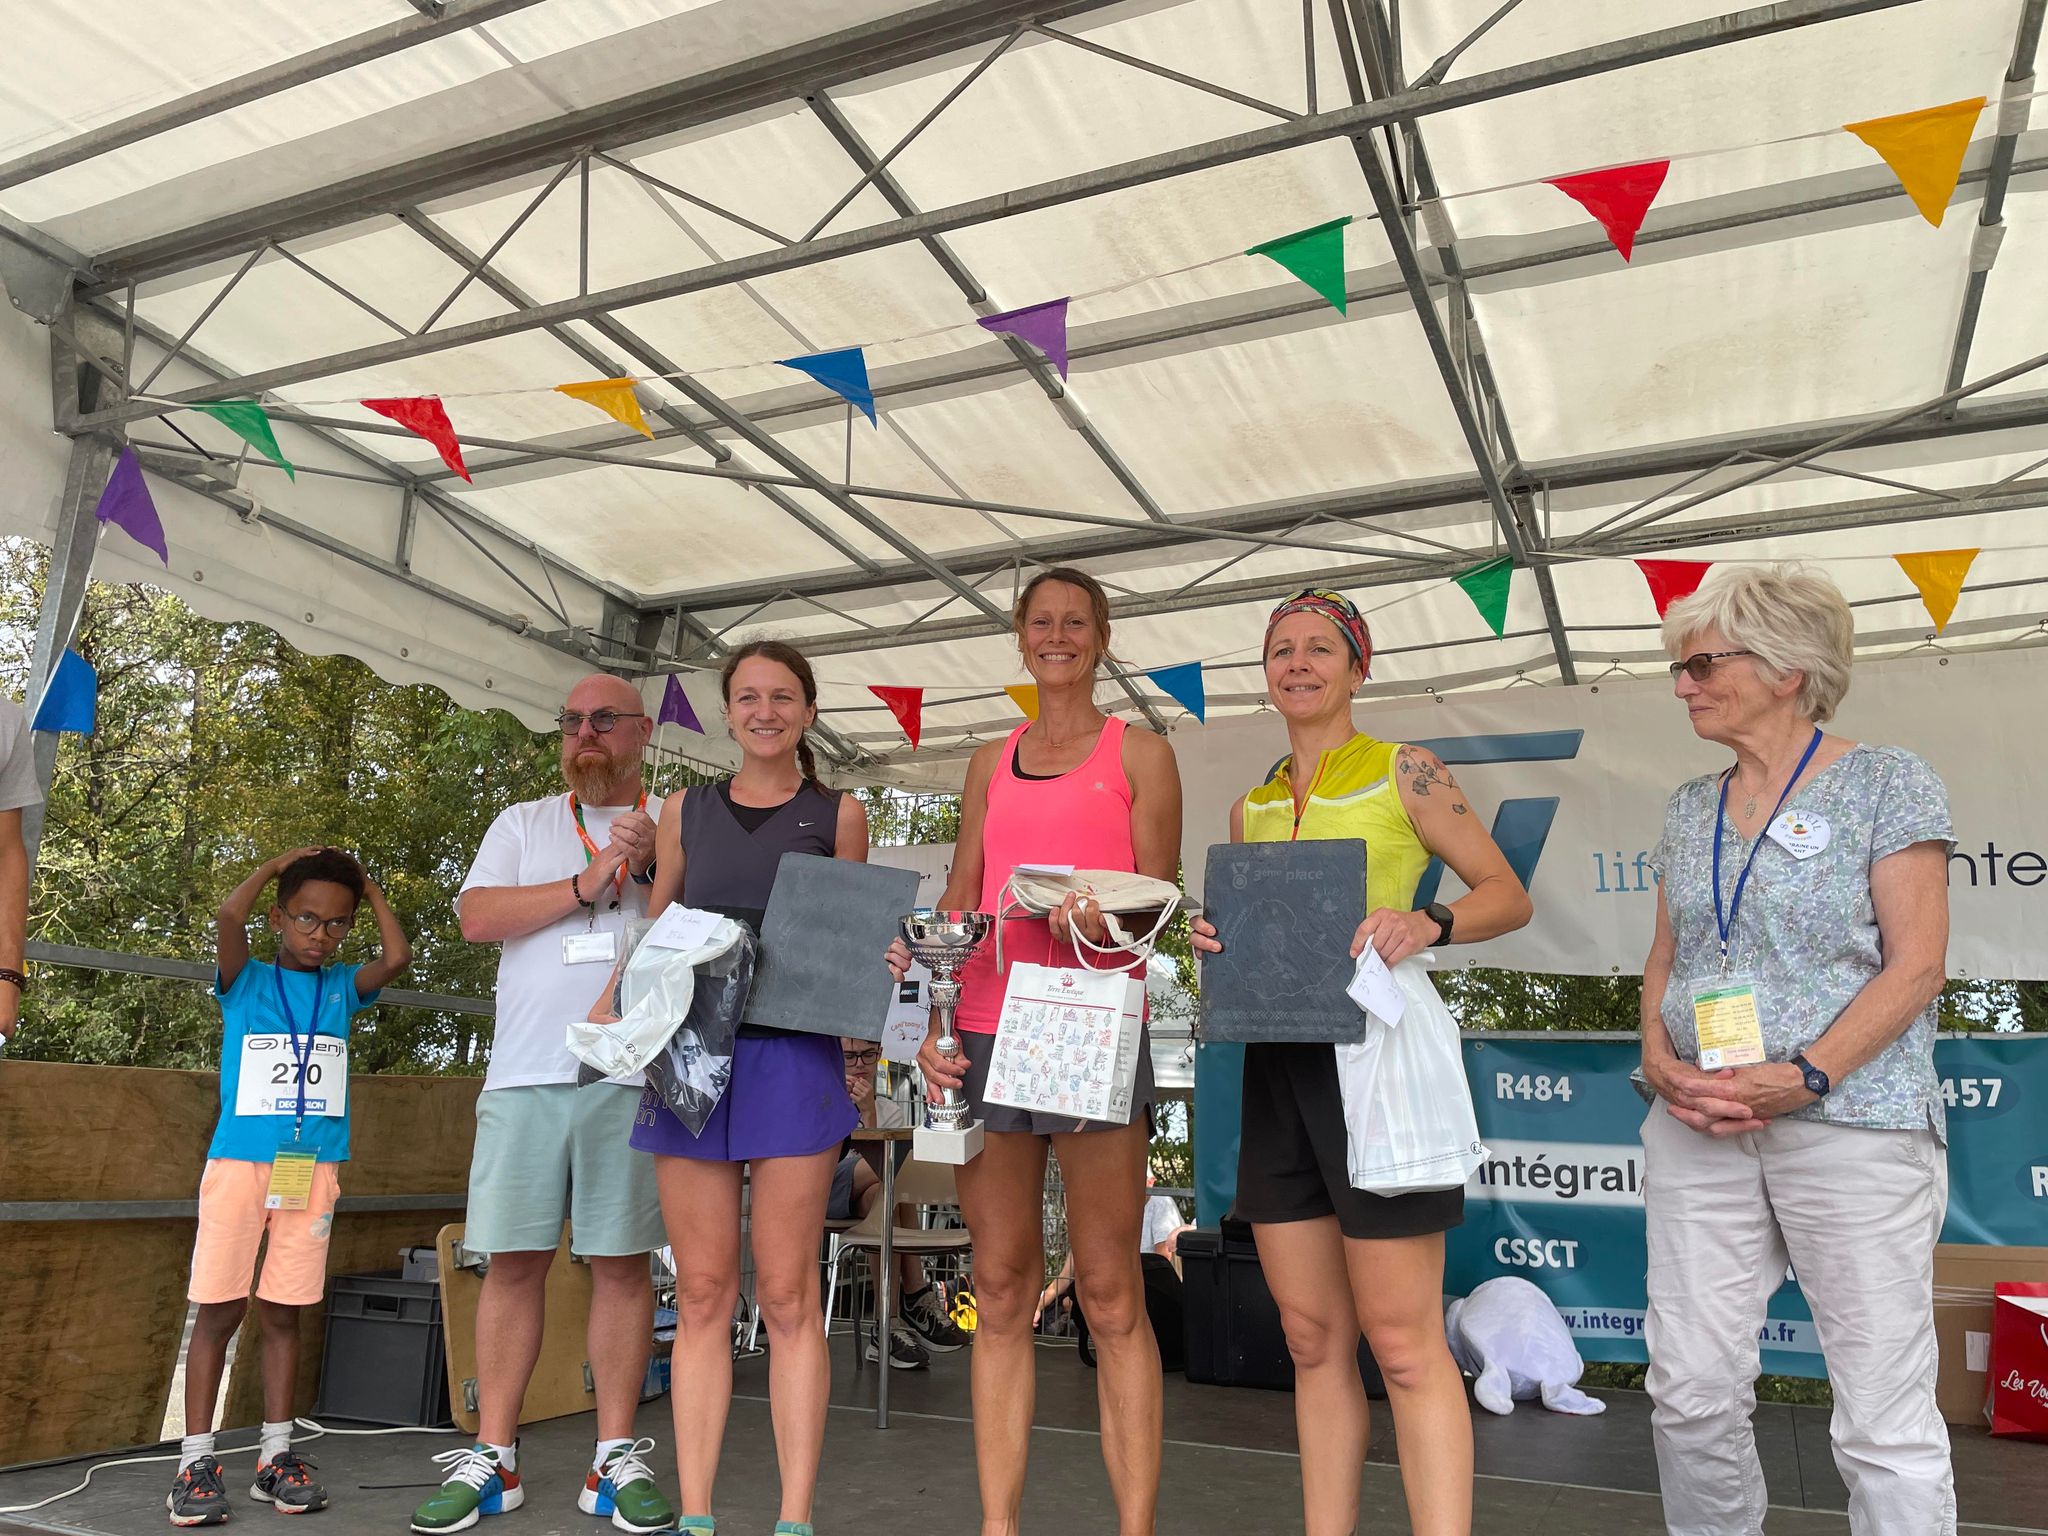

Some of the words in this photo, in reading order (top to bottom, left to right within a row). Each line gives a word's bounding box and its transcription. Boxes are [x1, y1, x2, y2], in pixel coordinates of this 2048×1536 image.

[1286, 869, 1324, 884] place
[271, 1062, 322, 1085] 270
[1496, 1072, 1573, 1102] R484
[278, 1100, 324, 1110] DECHLON
[1494, 1237, 1579, 1268] CSSCT
[2001, 1369, 2024, 1391] Les
